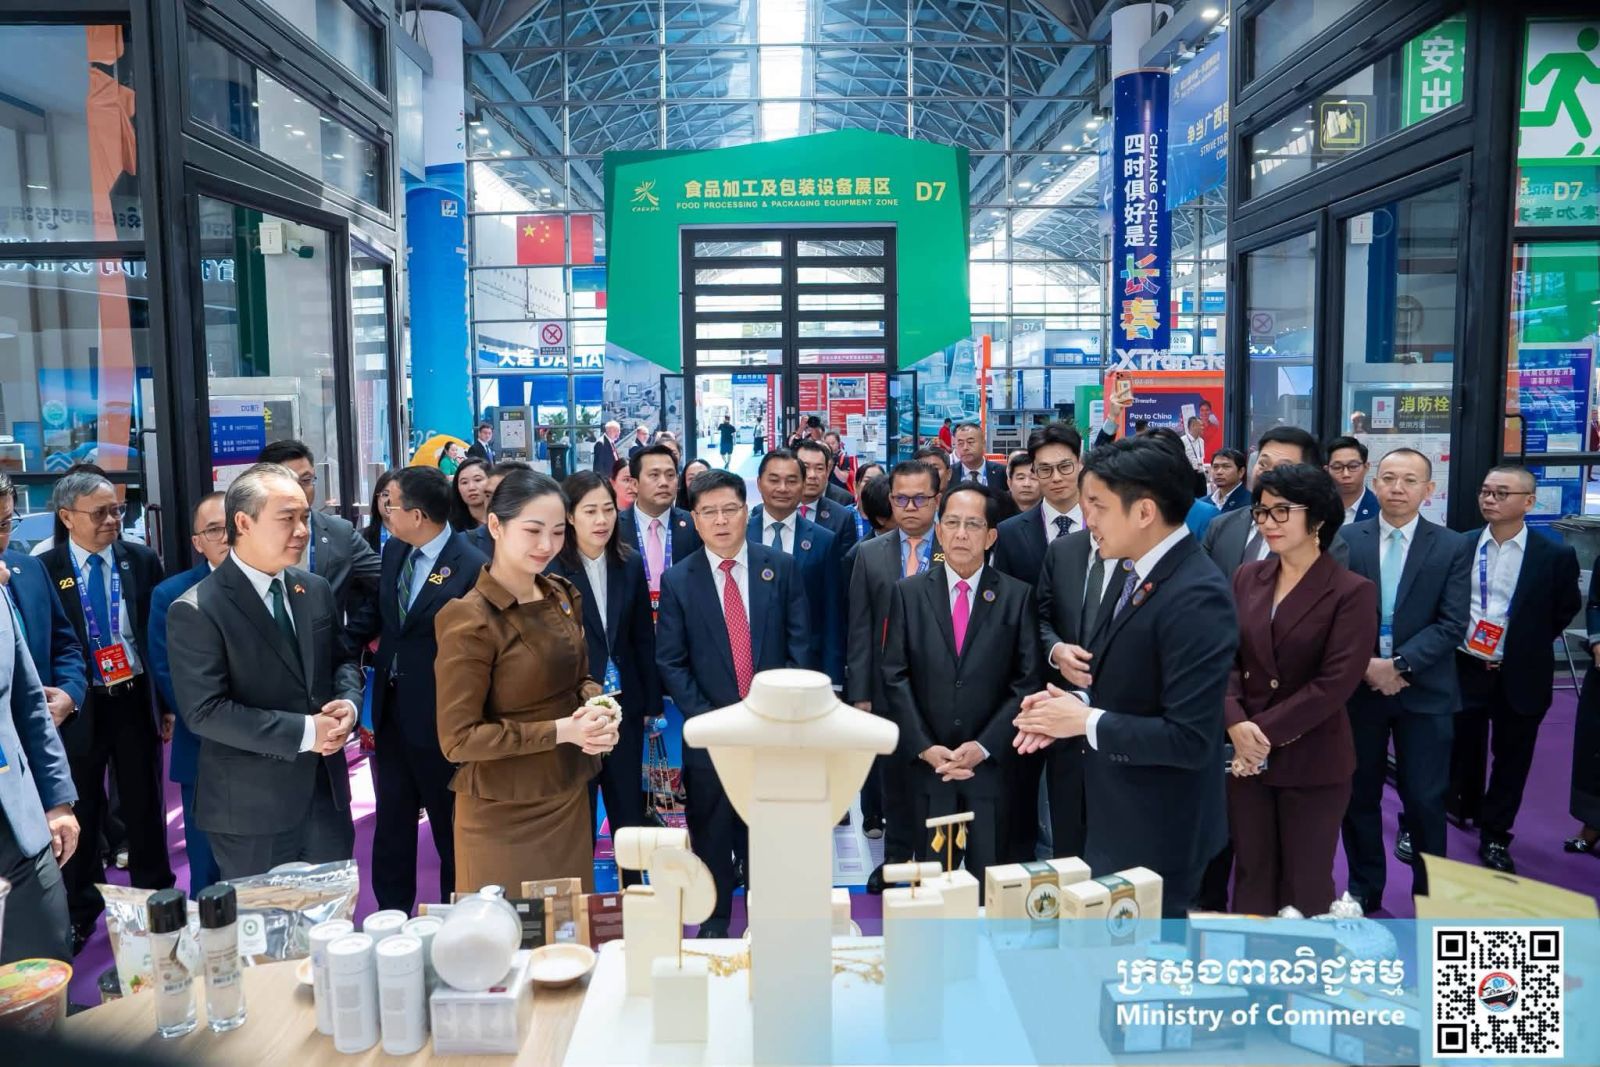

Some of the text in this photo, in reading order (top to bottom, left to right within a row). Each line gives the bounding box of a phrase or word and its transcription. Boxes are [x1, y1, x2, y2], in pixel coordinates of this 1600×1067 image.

[1421, 35, 1465, 74] 安
[684, 177, 891, 198] 食品加工及包装设备展区
[916, 181, 946, 201] D7
[1148, 133, 1159, 246] CHANG CHUN
[1554, 181, 1584, 201] D7
[676, 201, 700, 209] FOOD
[703, 200, 758, 209] PROCESSING
[771, 199, 820, 208] PACKAGING
[824, 198, 872, 207] EQUIPMENT
[876, 198, 899, 206] ZONE
[498, 347, 536, 367] 大连
[1399, 395, 1450, 412] 消防栓
